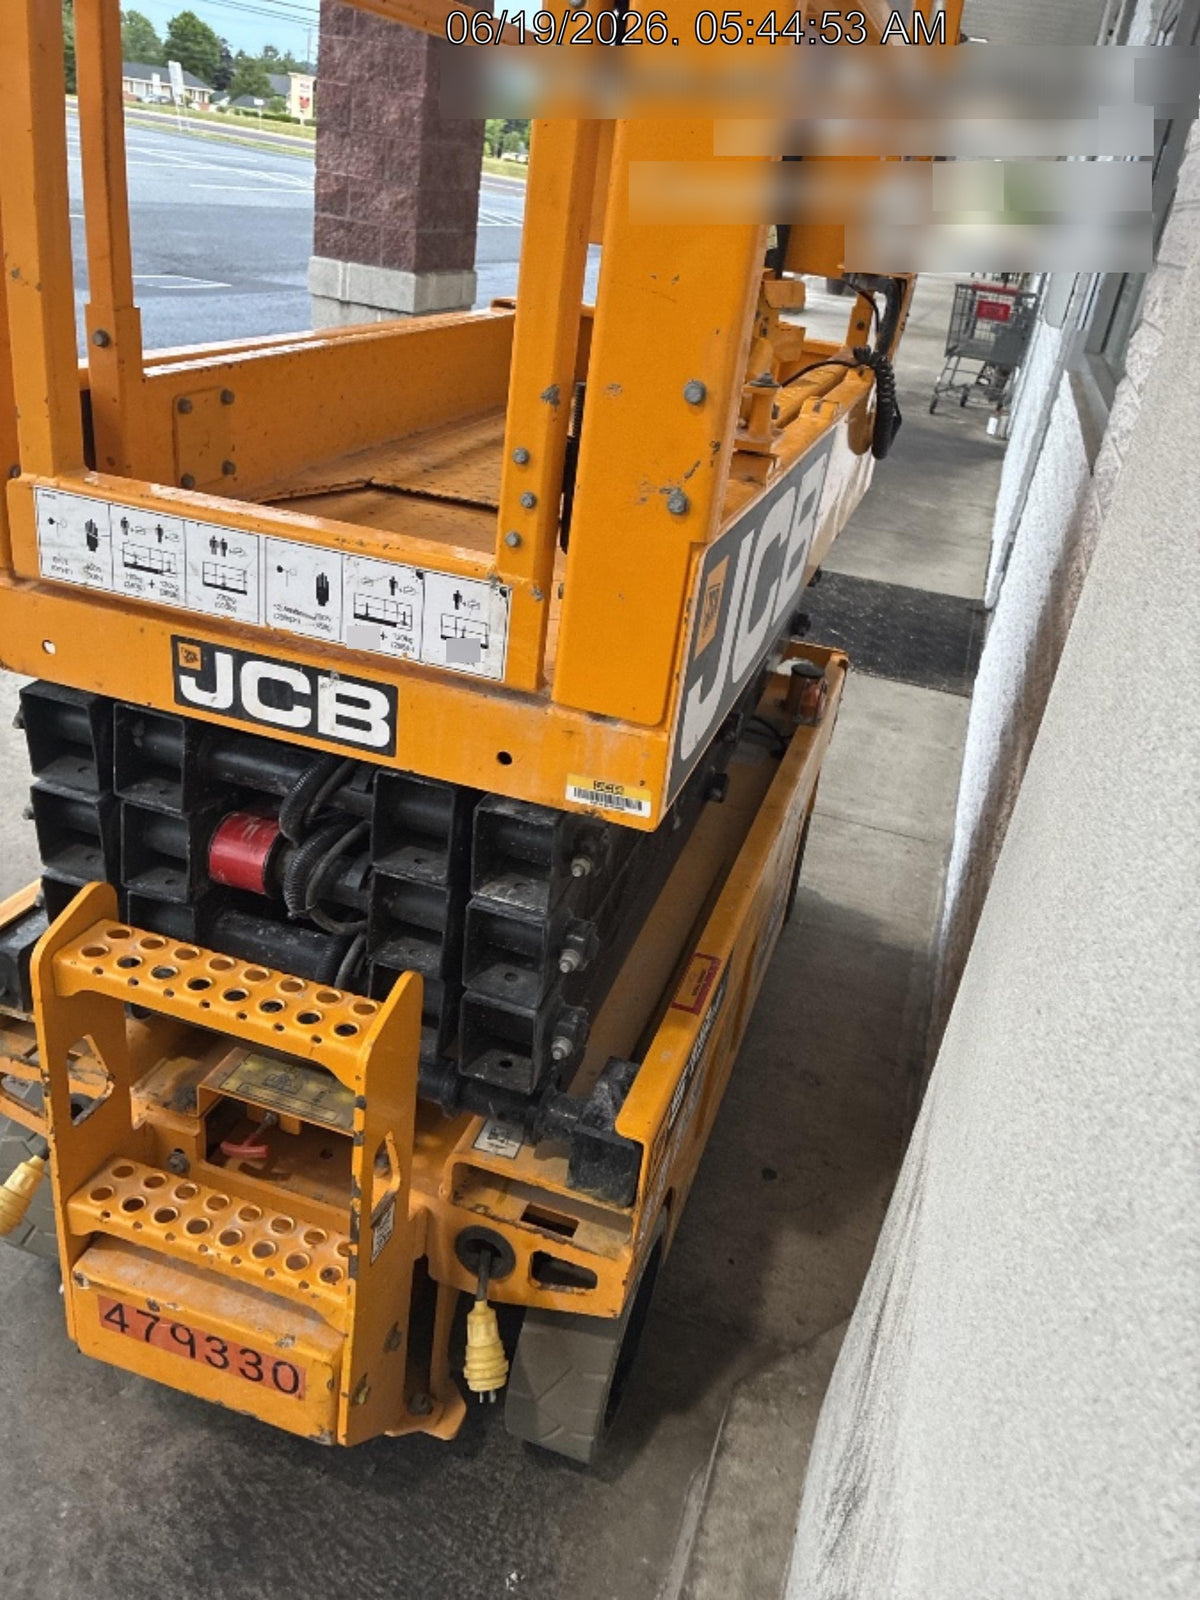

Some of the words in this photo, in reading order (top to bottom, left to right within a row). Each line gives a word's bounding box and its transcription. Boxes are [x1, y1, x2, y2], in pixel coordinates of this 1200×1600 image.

[681, 452, 827, 761] JCB
[179, 651, 391, 747] JCB
[104, 1302, 299, 1394] 479330
